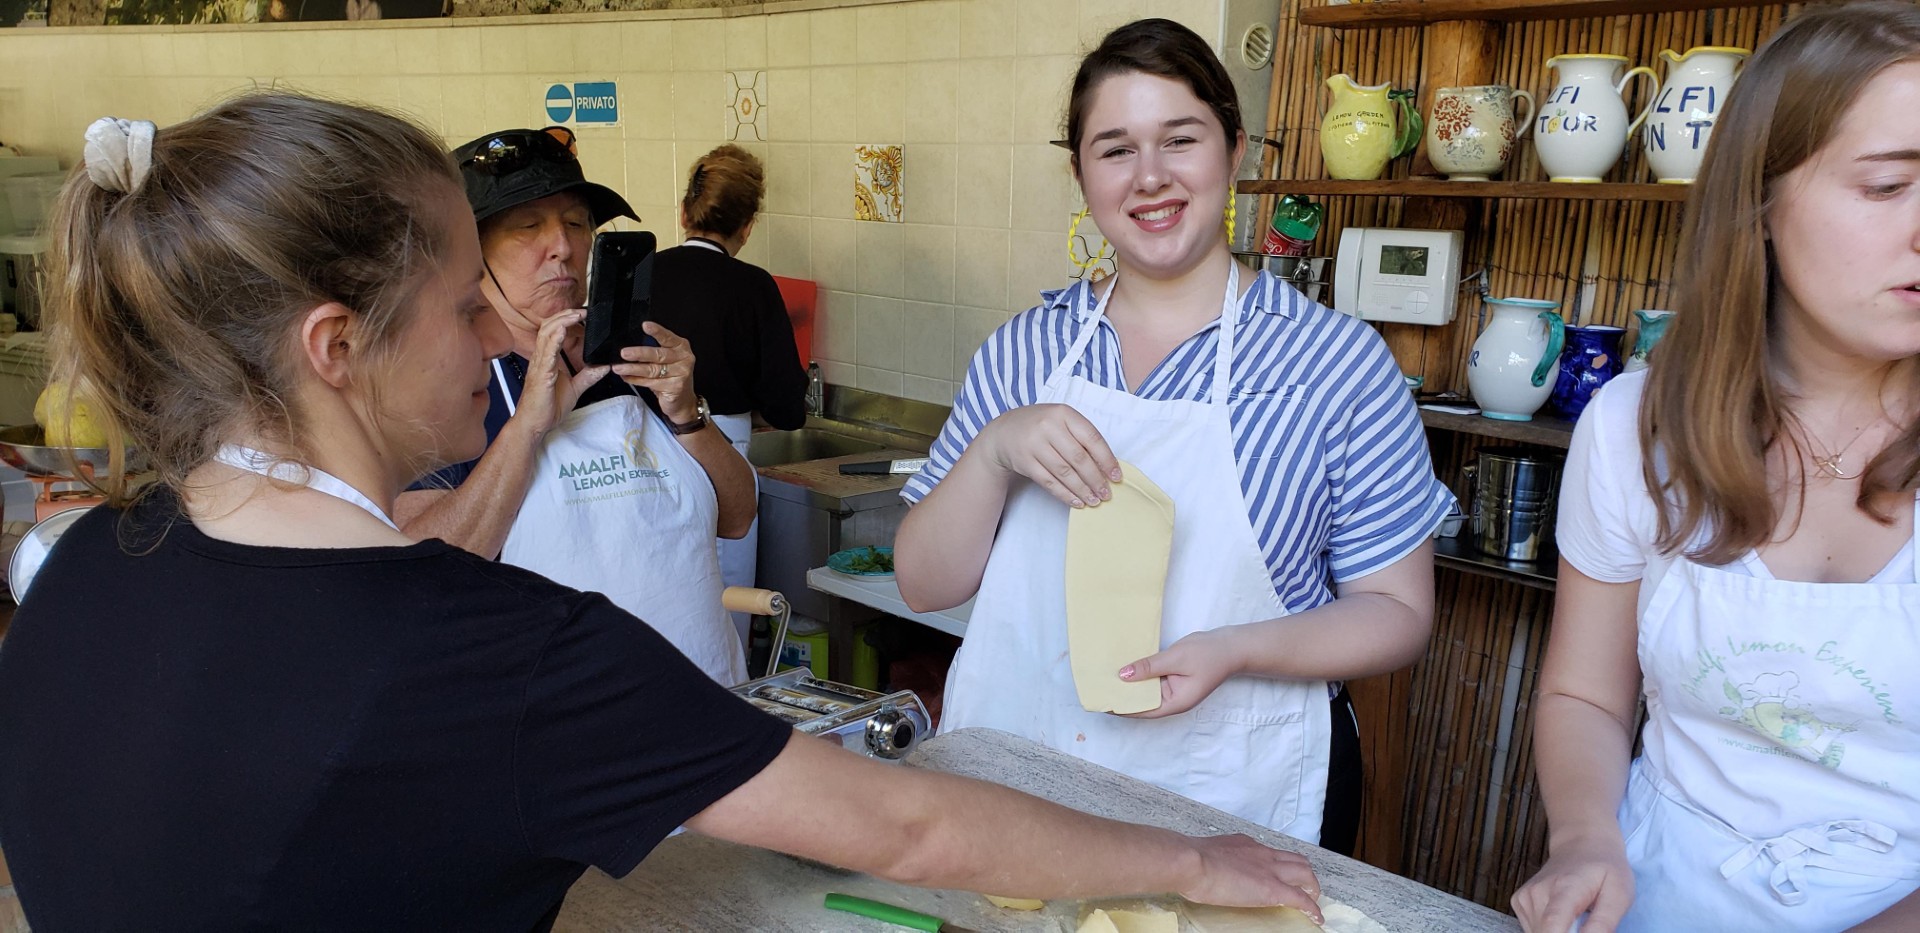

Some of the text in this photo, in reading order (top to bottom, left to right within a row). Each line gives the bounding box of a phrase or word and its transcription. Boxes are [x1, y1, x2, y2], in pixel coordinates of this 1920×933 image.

[576, 96, 615, 110] PRIVATO
[1356, 110, 1385, 119] GARDEN
[1685, 120, 1713, 150] T
[558, 455, 627, 479] AMALFI
[573, 472, 627, 491] LEMON
[1681, 647, 1727, 701] Amalfi
[1727, 635, 1805, 657] Lemon
